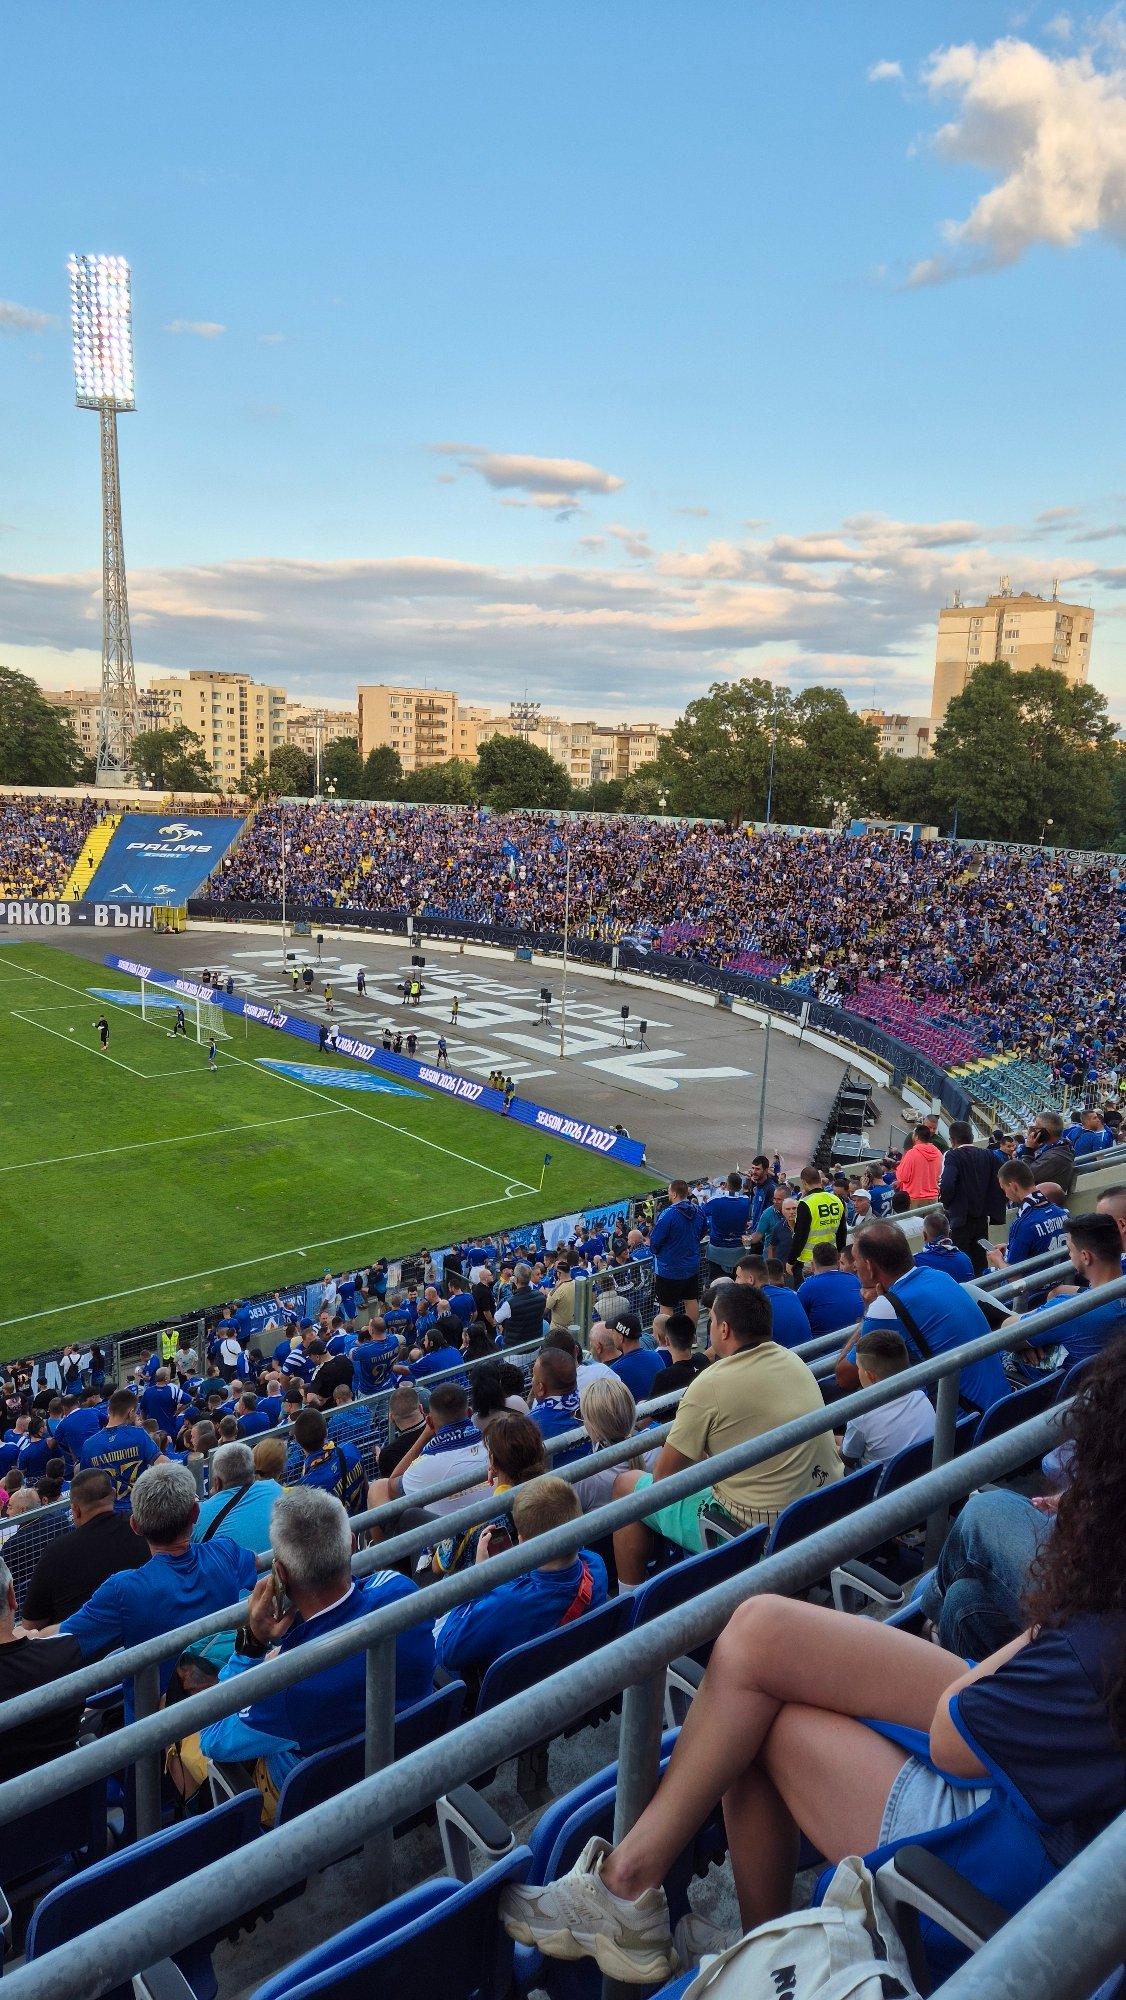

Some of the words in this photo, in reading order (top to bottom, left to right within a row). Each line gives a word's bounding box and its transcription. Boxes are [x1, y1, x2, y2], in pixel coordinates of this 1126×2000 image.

[126, 842, 213, 853] PALMS
[418, 1067, 440, 1084] SEASON
[438, 1074, 457, 1092] 2026
[458, 1079, 483, 1100] 2027
[536, 1111, 563, 1132] SEASON
[560, 1120, 584, 1142] 2026
[586, 1126, 617, 1151] 2027
[817, 1202, 840, 1218] BG
[615, 1321, 631, 1336] 1914
